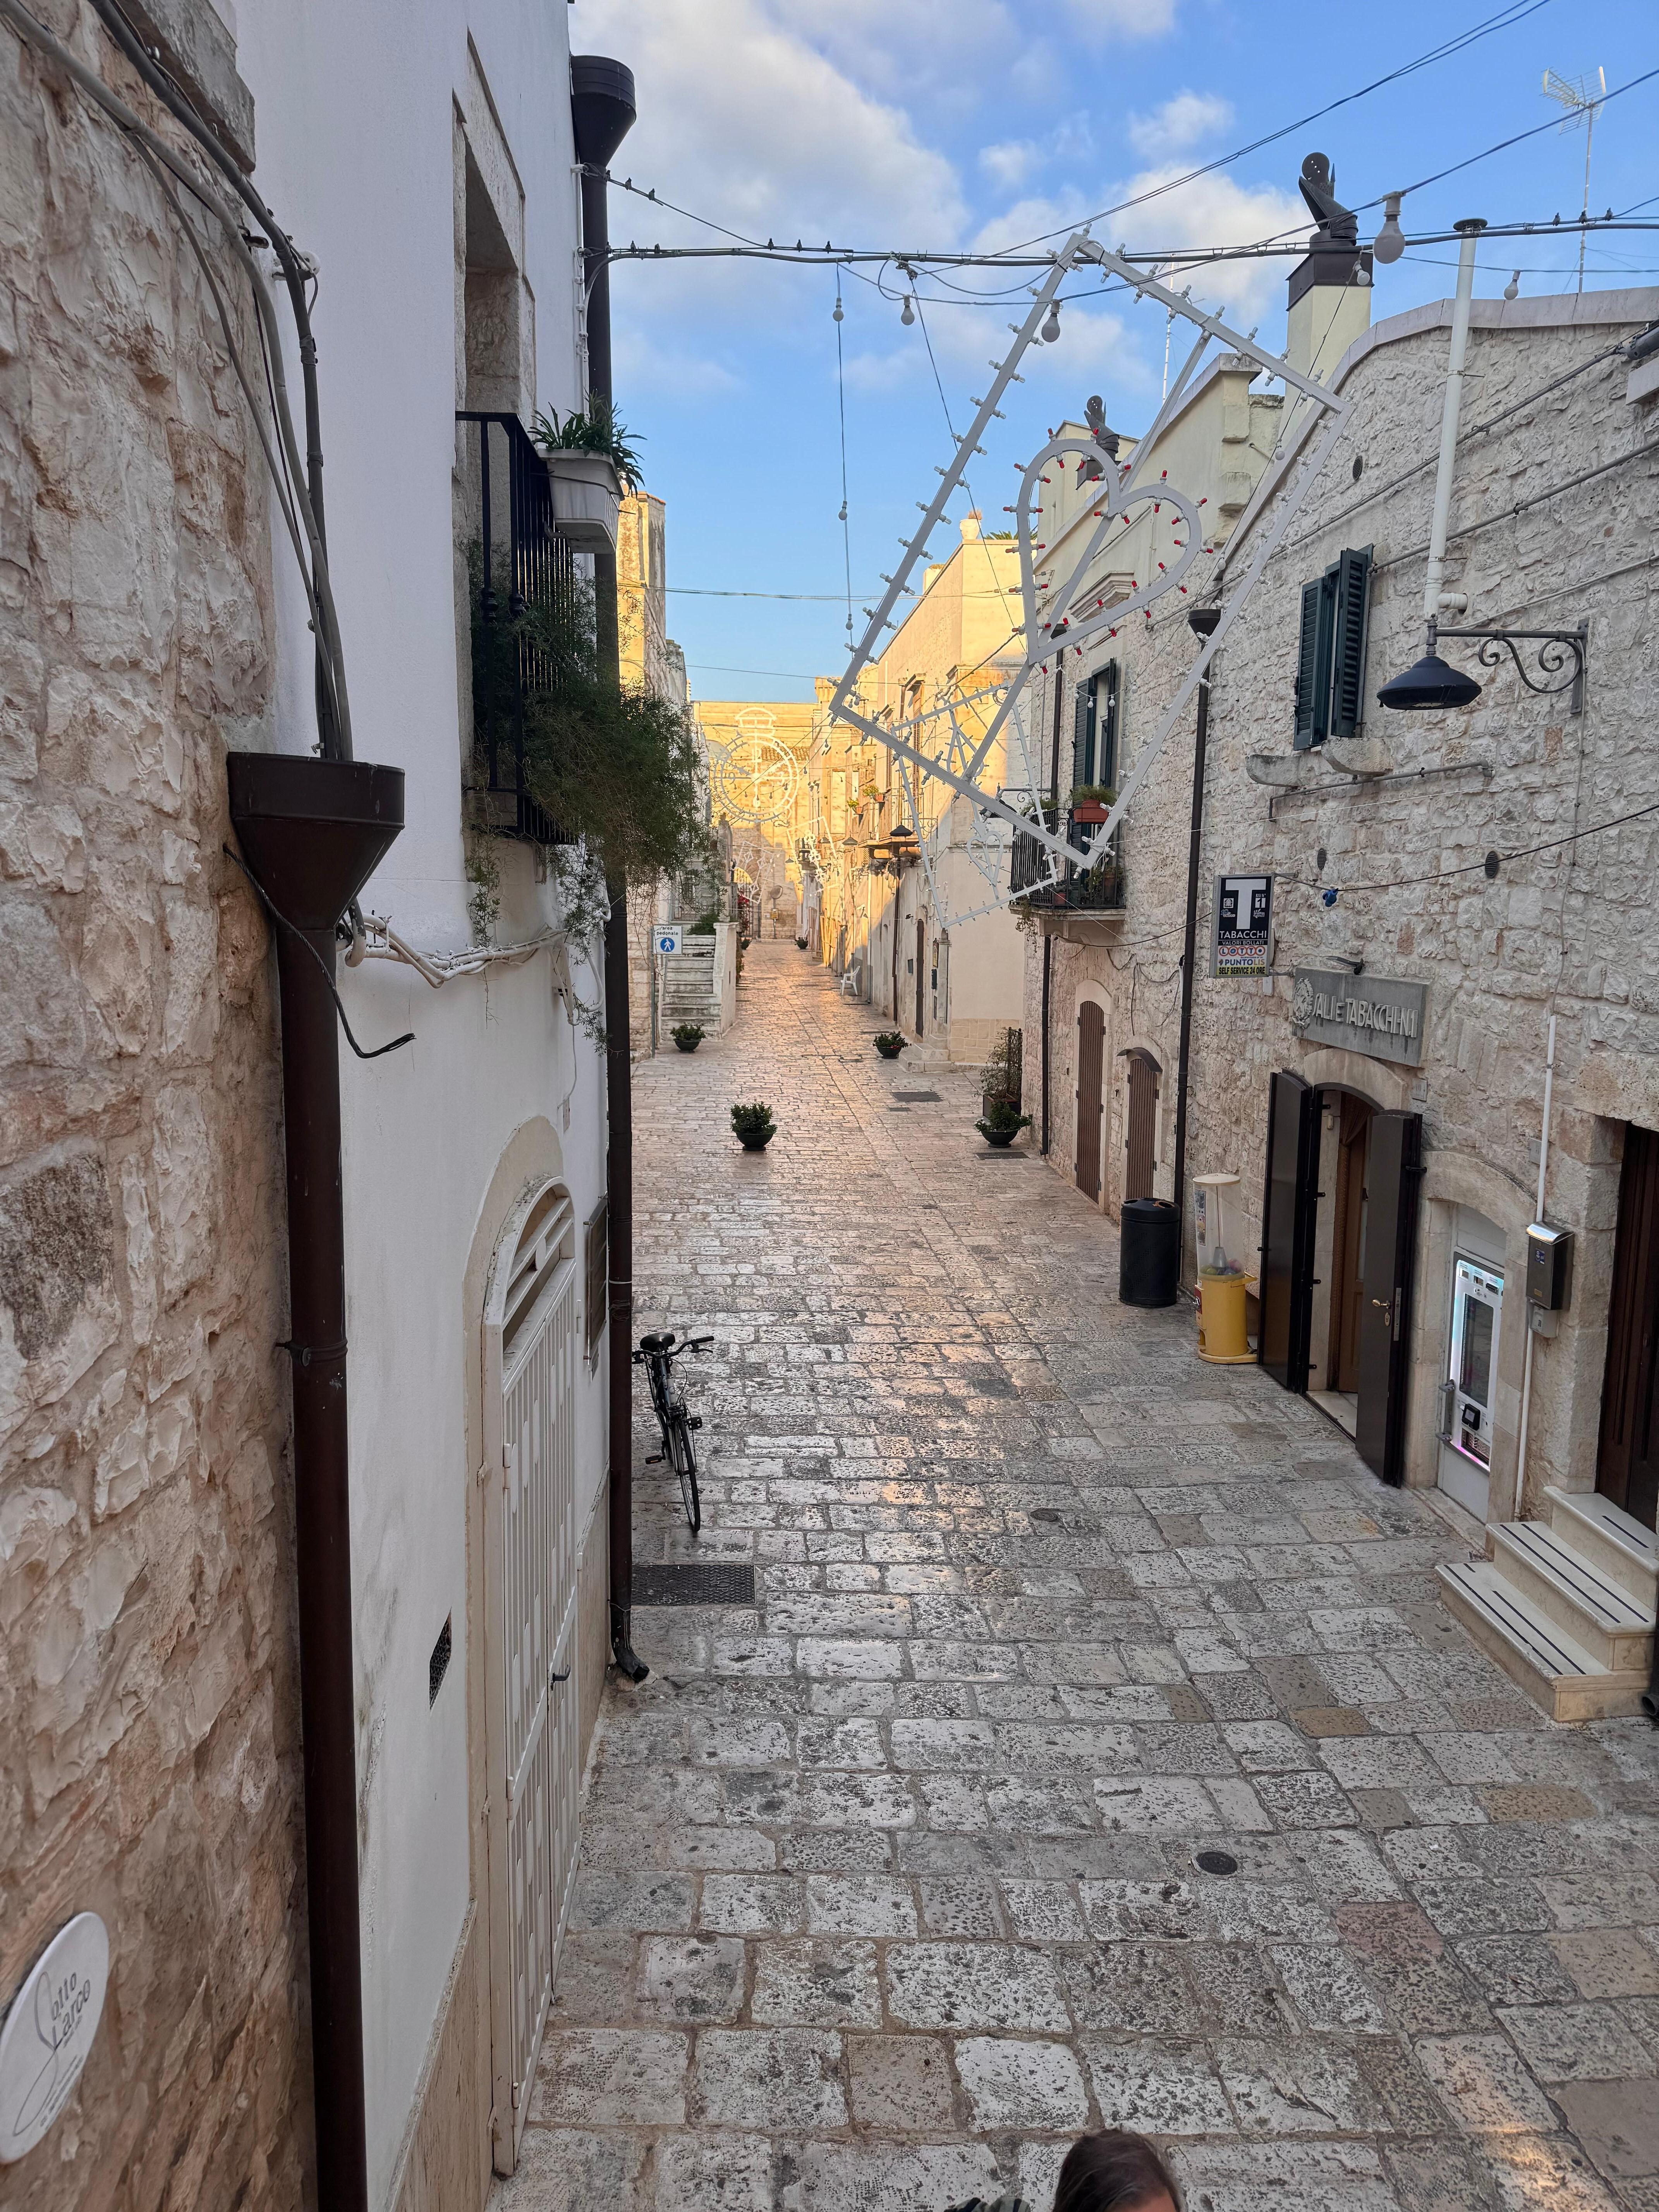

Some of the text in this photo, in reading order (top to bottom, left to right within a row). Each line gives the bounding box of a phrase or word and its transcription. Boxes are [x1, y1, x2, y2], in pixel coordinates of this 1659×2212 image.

[1225, 879, 1266, 929] T
[1257, 898, 1262, 908] 1
[1219, 931, 1267, 939] TABACCHI
[1219, 946, 1266, 957] LOTTO
